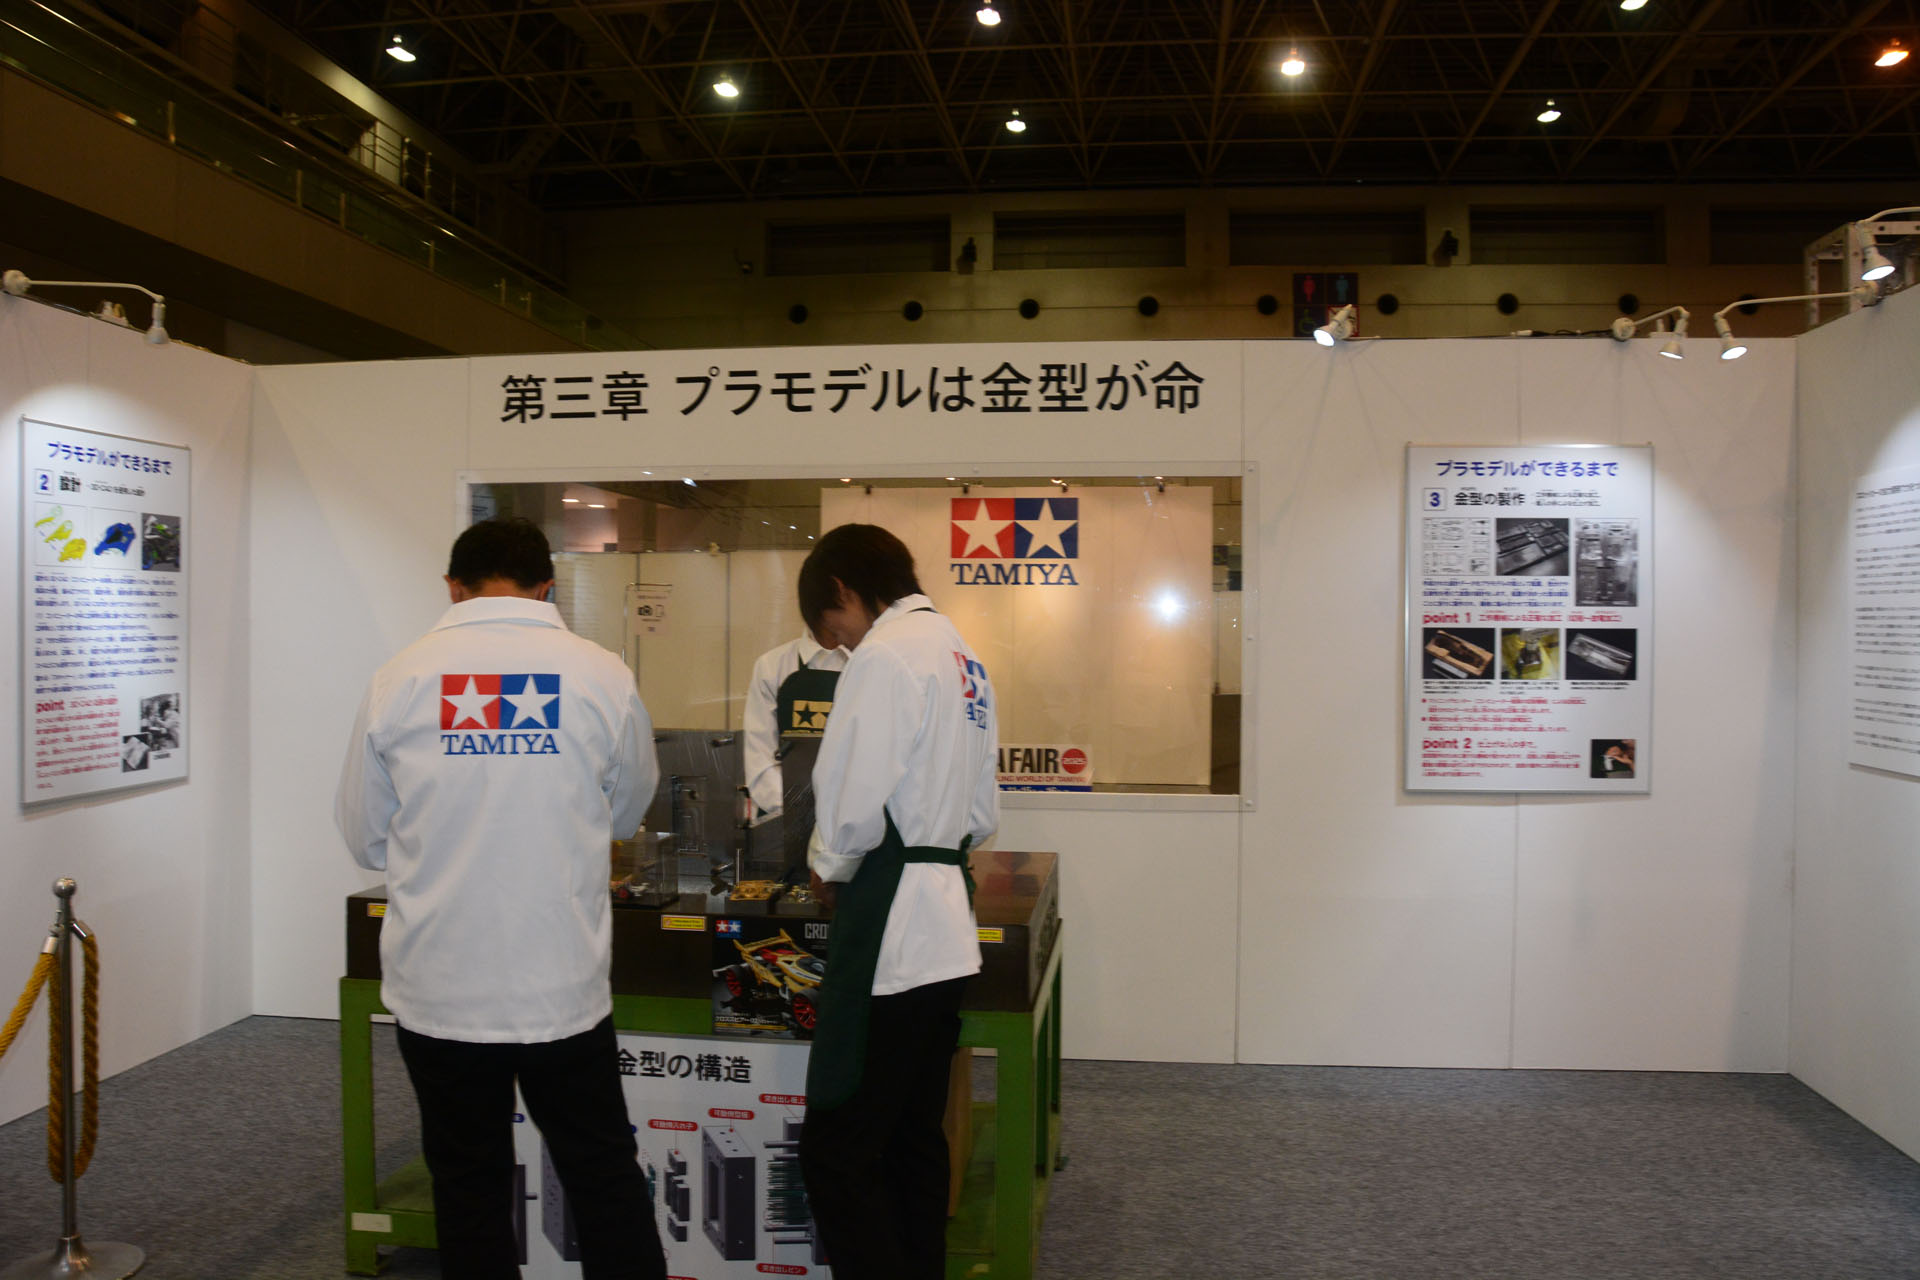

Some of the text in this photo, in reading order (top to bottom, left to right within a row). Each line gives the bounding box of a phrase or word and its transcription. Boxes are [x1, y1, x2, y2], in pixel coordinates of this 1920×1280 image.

[501, 359, 1204, 423] 第三章 プラモデルは金型が命
[47, 441, 173, 475] プラモデルができるまで
[1436, 460, 1620, 477] プラモデルができるまで
[39, 474, 49, 490] 2
[1429, 492, 1440, 507] 3
[1454, 491, 1526, 507] 金型の製作
[950, 563, 1079, 585] TAMIYA
[1423, 612, 1459, 624] point
[441, 733, 560, 755] TAMIYA
[1423, 737, 1472, 750] point 2
[1009, 748, 1059, 773] FAIR
[804, 923, 829, 939] CRO
[617, 1048, 751, 1083] 金型の構造
